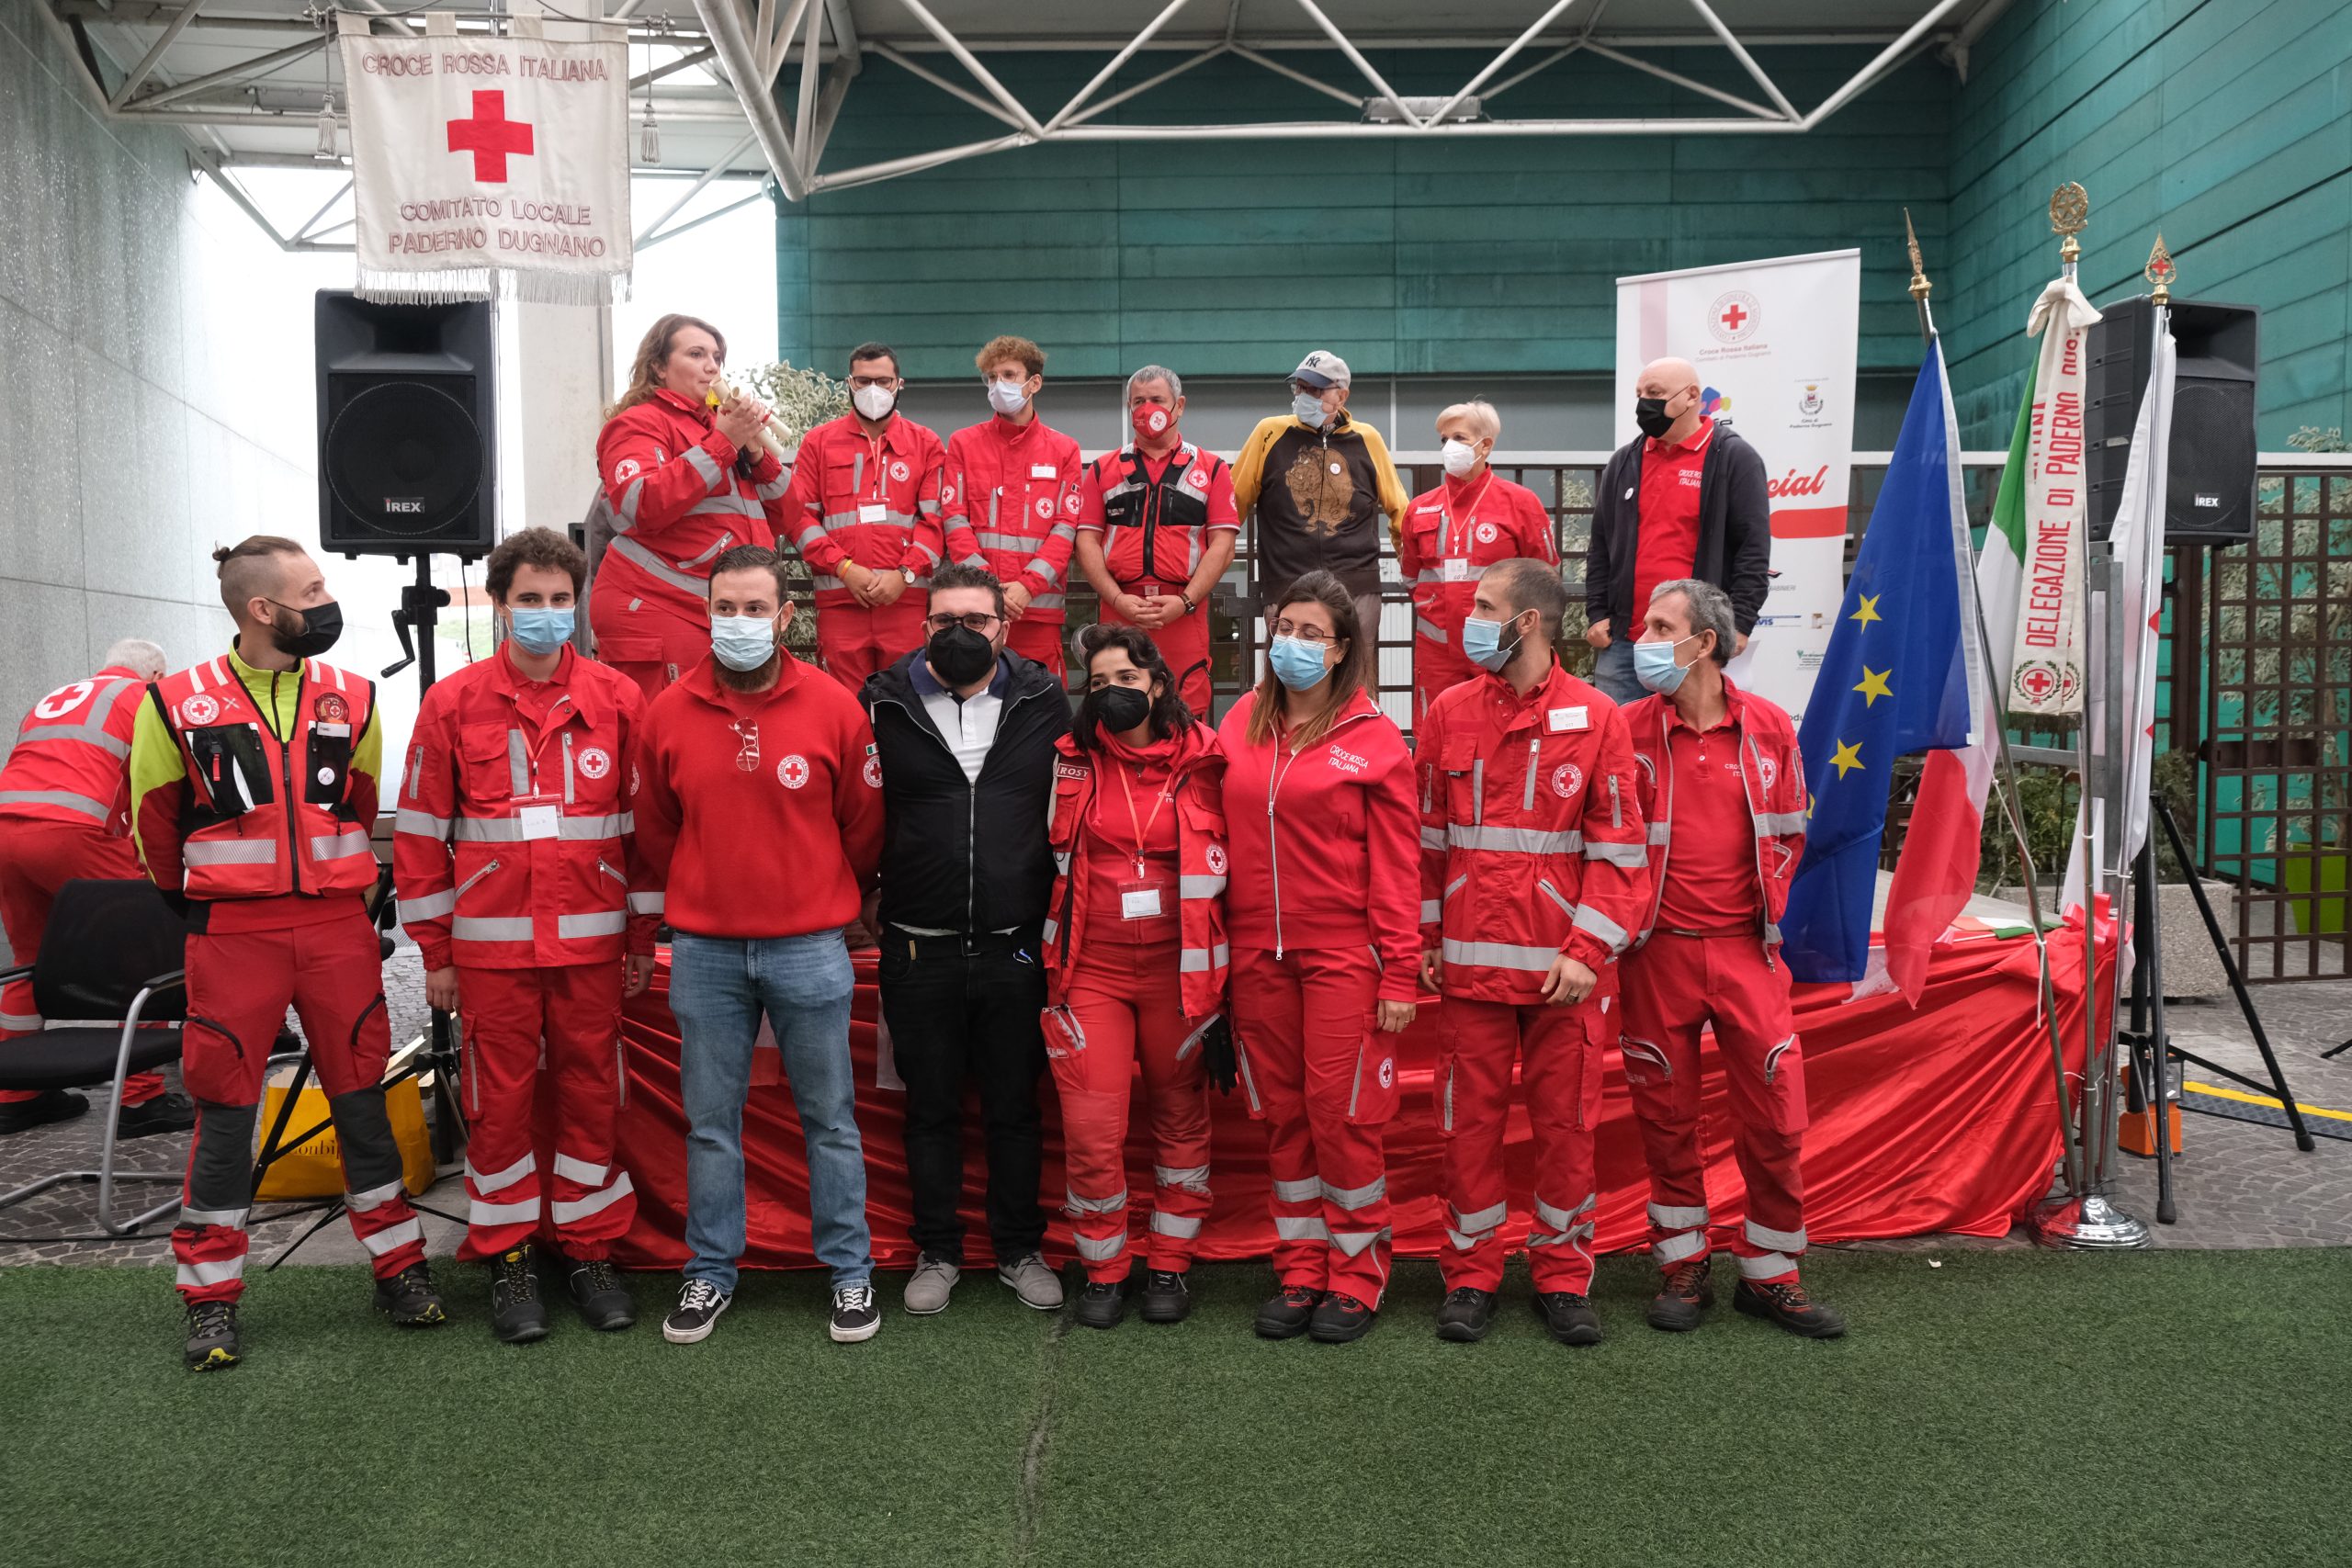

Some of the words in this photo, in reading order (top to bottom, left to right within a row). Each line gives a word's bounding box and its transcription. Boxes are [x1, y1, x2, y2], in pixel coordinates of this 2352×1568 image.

[363, 52, 433, 77] CROCE
[443, 52, 511, 76] ROSSA
[519, 55, 608, 82] ITALIANA
[401, 197, 502, 221] COMITATO
[512, 198, 592, 225] LOCALE
[389, 227, 487, 254] PADERNO
[498, 230, 606, 257] DUGNANO
[2045, 392, 2082, 476] PADERNO
[1767, 464, 1829, 499] cial
[2047, 489, 2075, 506] DI
[2026, 520, 2071, 647] DELEGAZIONE
[1329, 757, 1359, 775] ITALIANA
[1330, 745, 1351, 761] CROCE
[1349, 755, 1369, 769] ROSSA
